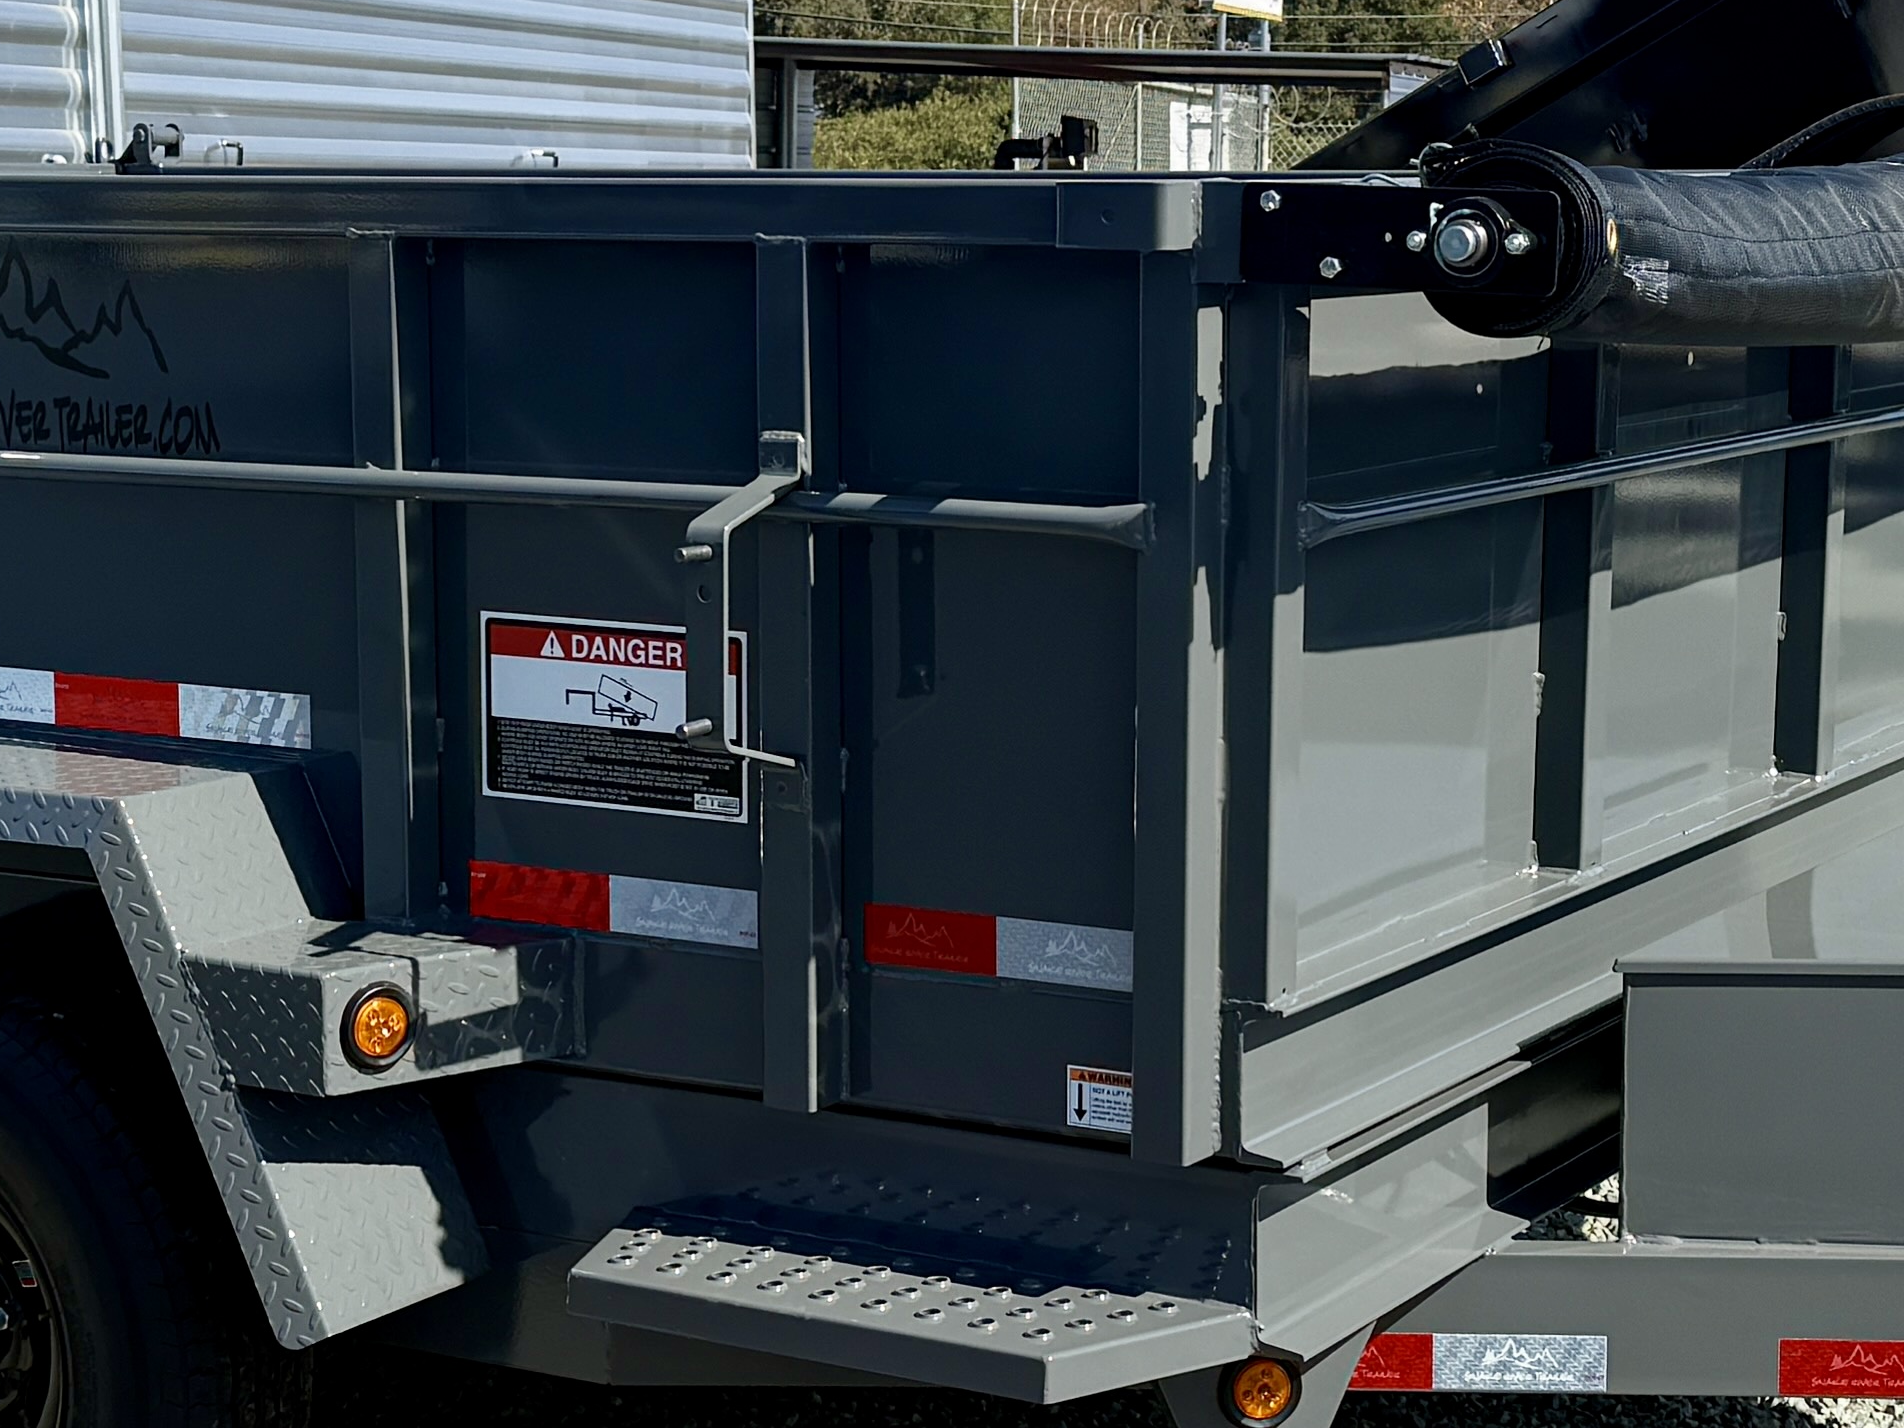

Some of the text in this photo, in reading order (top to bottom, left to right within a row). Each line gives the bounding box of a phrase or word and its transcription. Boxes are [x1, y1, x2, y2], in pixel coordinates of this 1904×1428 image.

[53, 396, 221, 456] TRAILER.COM
[570, 633, 683, 668] DANGER
[1087, 1070, 1132, 1088] WARNIN
